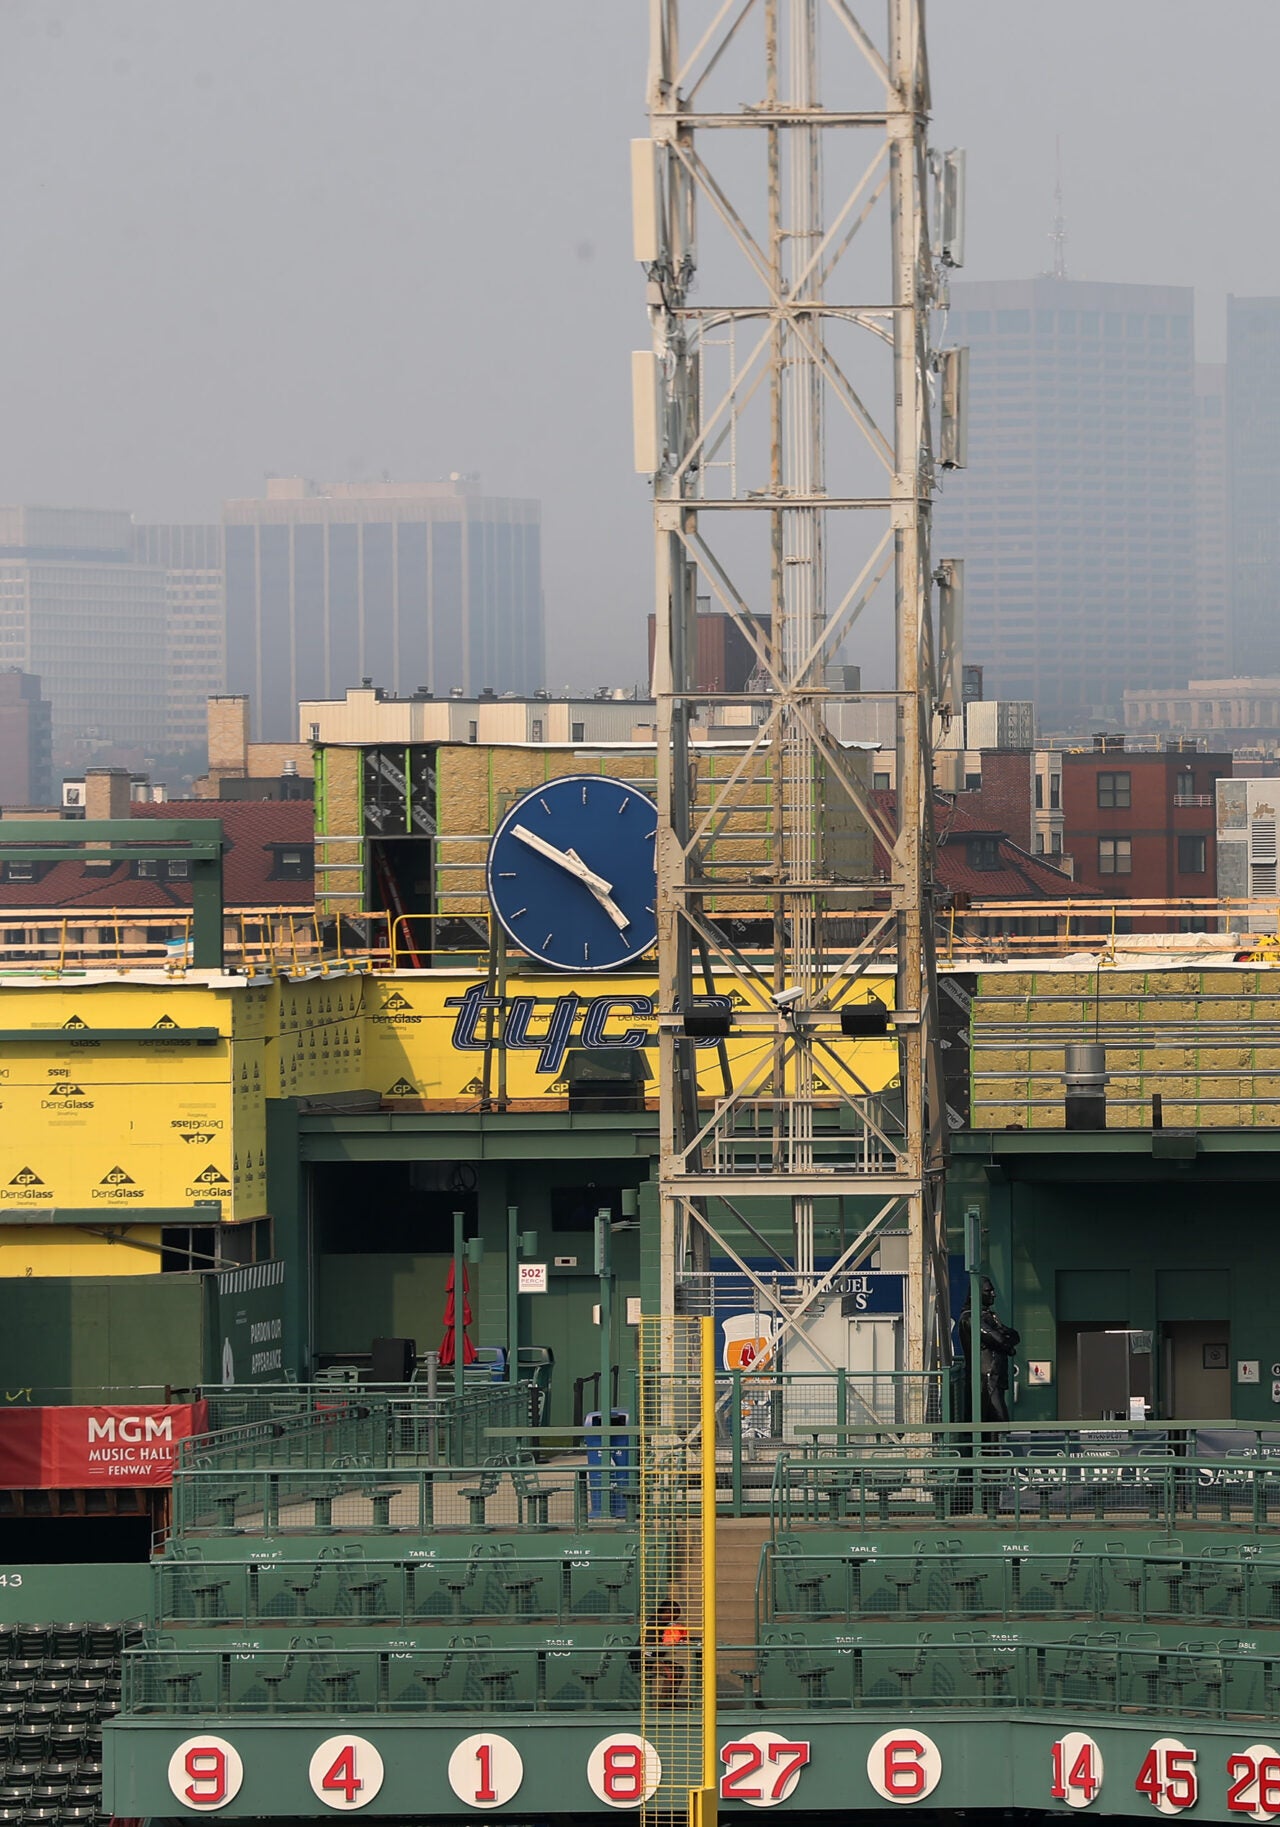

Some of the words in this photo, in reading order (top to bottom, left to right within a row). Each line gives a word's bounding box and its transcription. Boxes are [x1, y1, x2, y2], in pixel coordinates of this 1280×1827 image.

[387, 999, 405, 1009] GP
[372, 1014, 422, 1024] DensGlass
[56, 1084, 77, 1095] GP
[393, 1085, 412, 1095] GP
[551, 1083, 569, 1093] GP
[41, 1100, 94, 1109] DensGlass
[170, 1120, 223, 1129] DensGlass
[16, 1174, 36, 1184] GP
[107, 1173, 127, 1183] GP
[201, 1171, 221, 1182] GP
[1, 1190, 53, 1199] DensGlass
[92, 1188, 145, 1198] DensGlass
[251, 1348, 282, 1375] APPEARANCE
[88, 1416, 172, 1443] MGM
[88, 1448, 135, 1462] MUSIC
[140, 1447, 172, 1461] HALL
[108, 1465, 152, 1476] FENWAY
[321, 1744, 363, 1801] 4
[475, 1744, 498, 1801] 1
[603, 1744, 643, 1801] 8
[720, 1741, 811, 1800] 27
[884, 1739, 928, 1797] 6
[1051, 1741, 1098, 1800] 14
[184, 1746, 228, 1803] 9
[1135, 1749, 1198, 1808] 45
